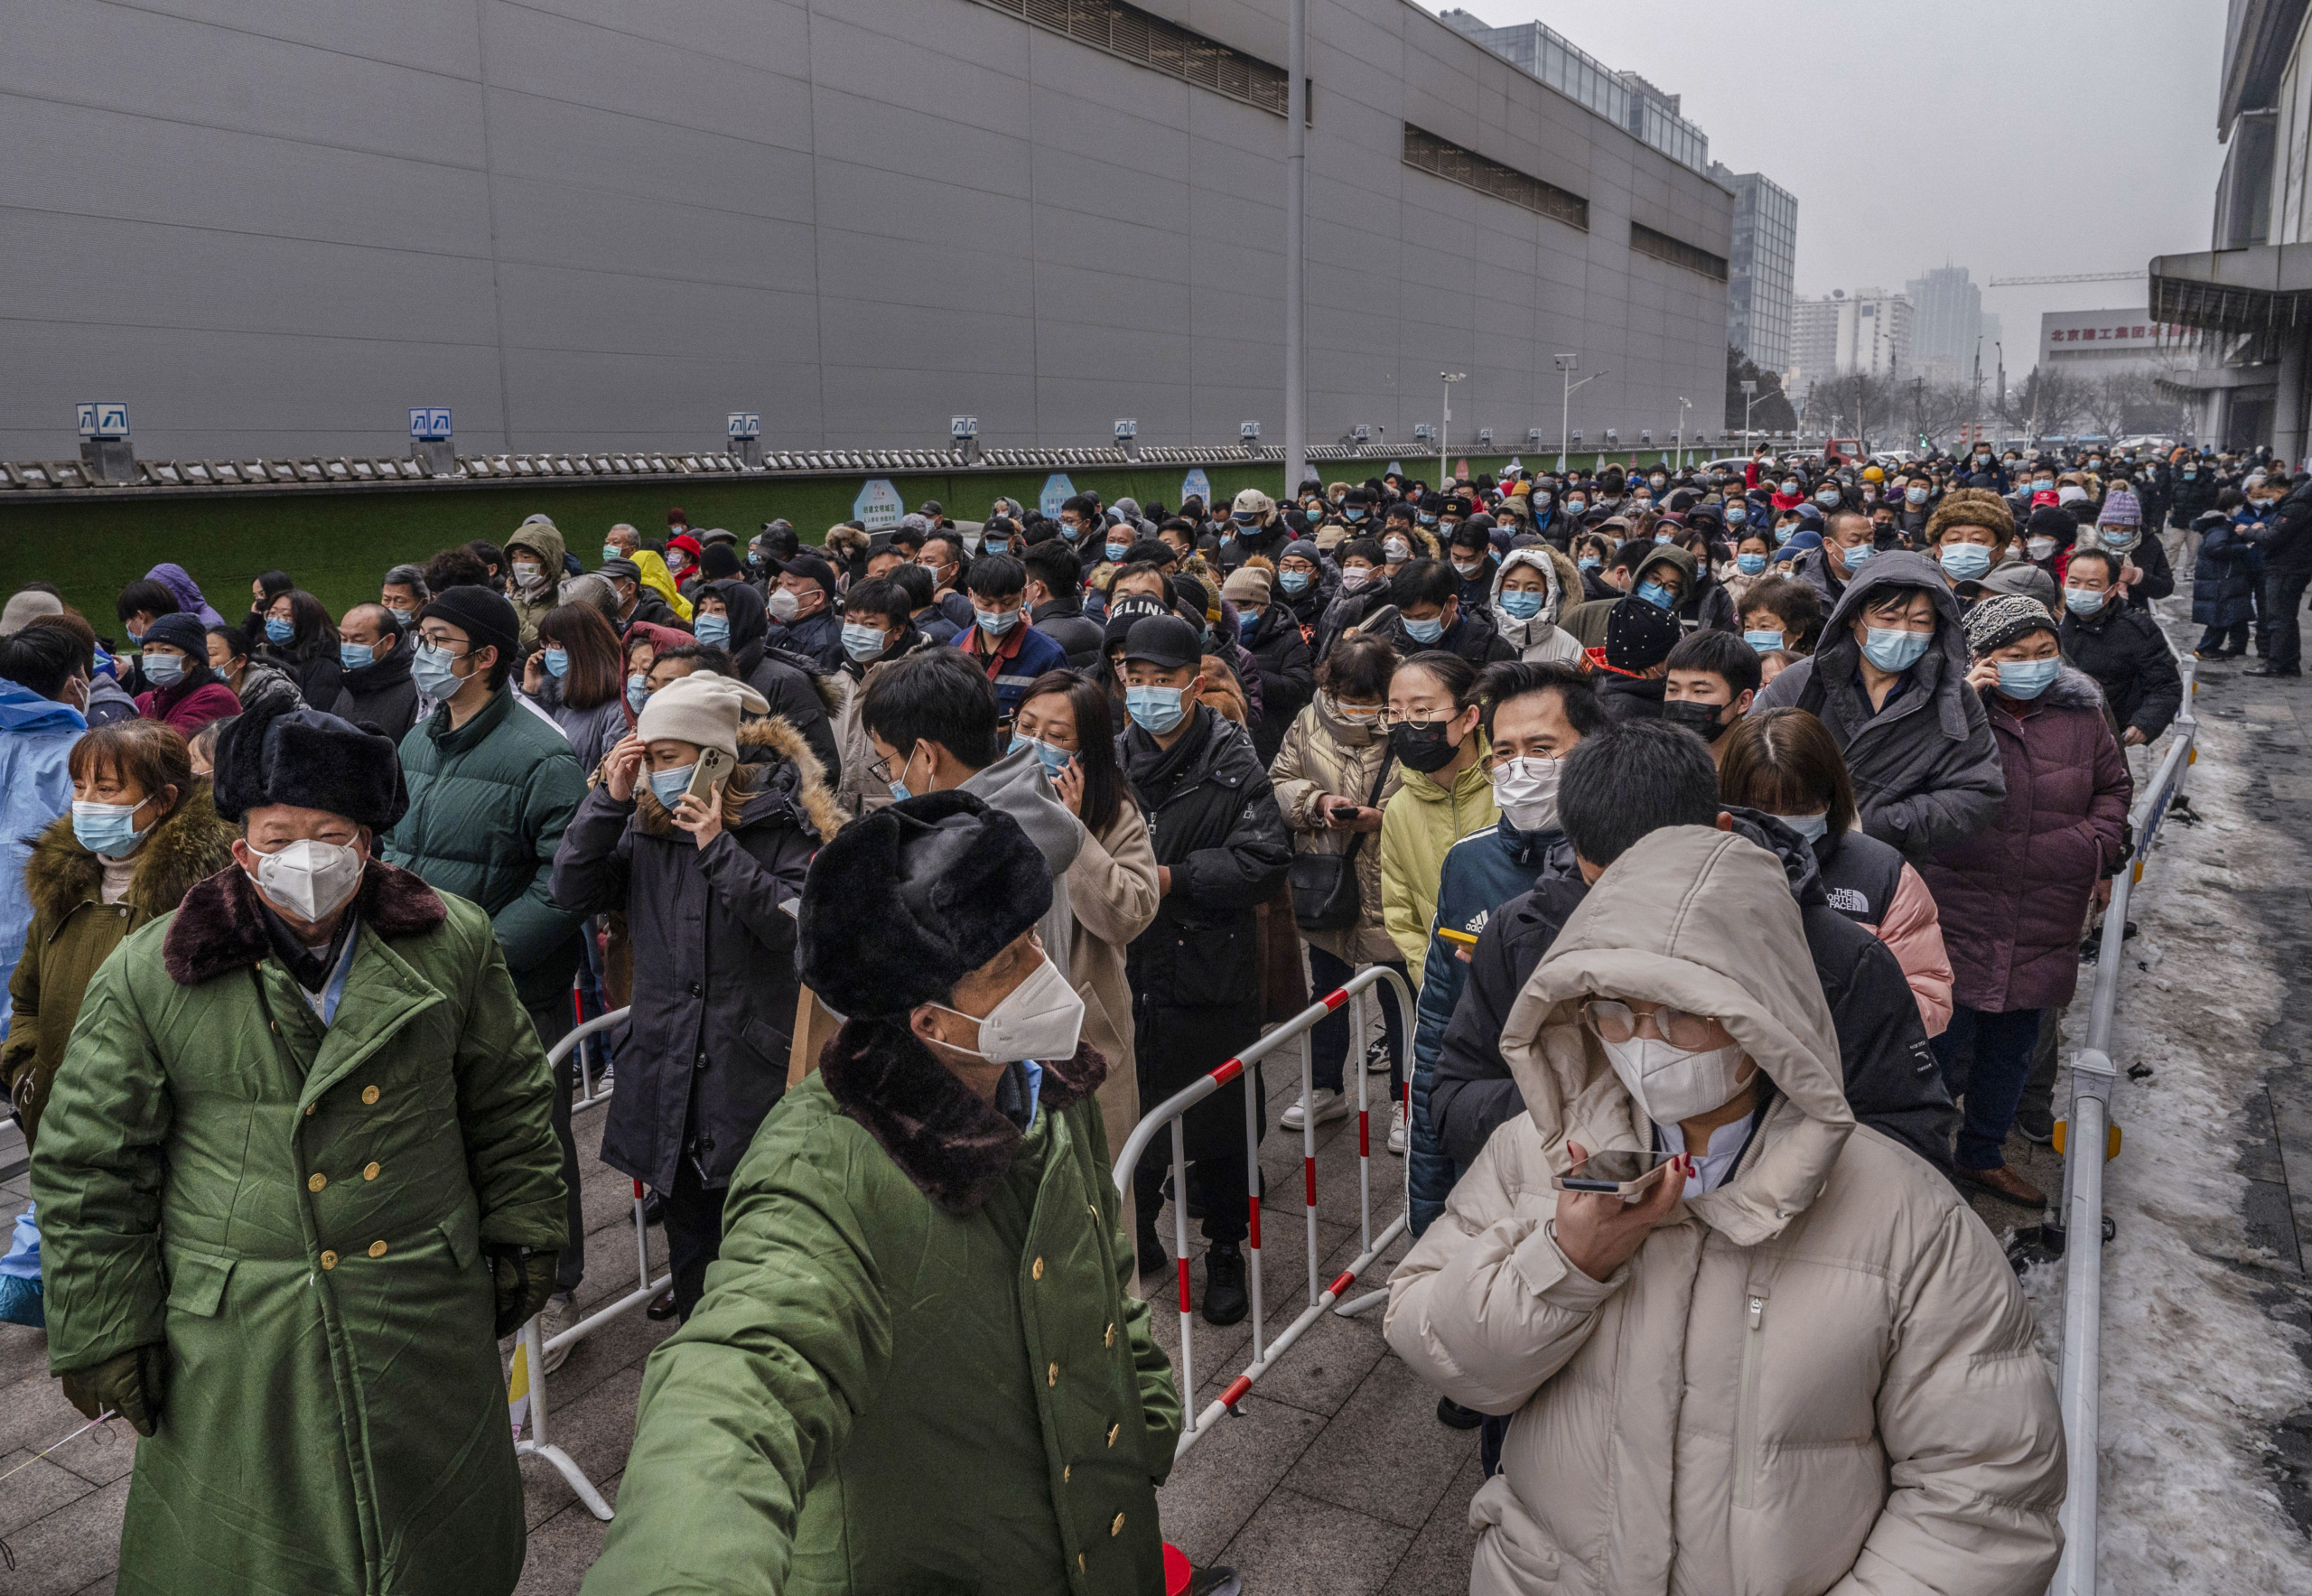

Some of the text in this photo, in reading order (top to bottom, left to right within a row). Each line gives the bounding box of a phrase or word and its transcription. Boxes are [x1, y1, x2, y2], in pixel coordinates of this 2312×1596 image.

[1833, 887, 1853, 896] THE
[1826, 893, 1852, 903] ORTH
[1829, 901, 1852, 910] FACE
